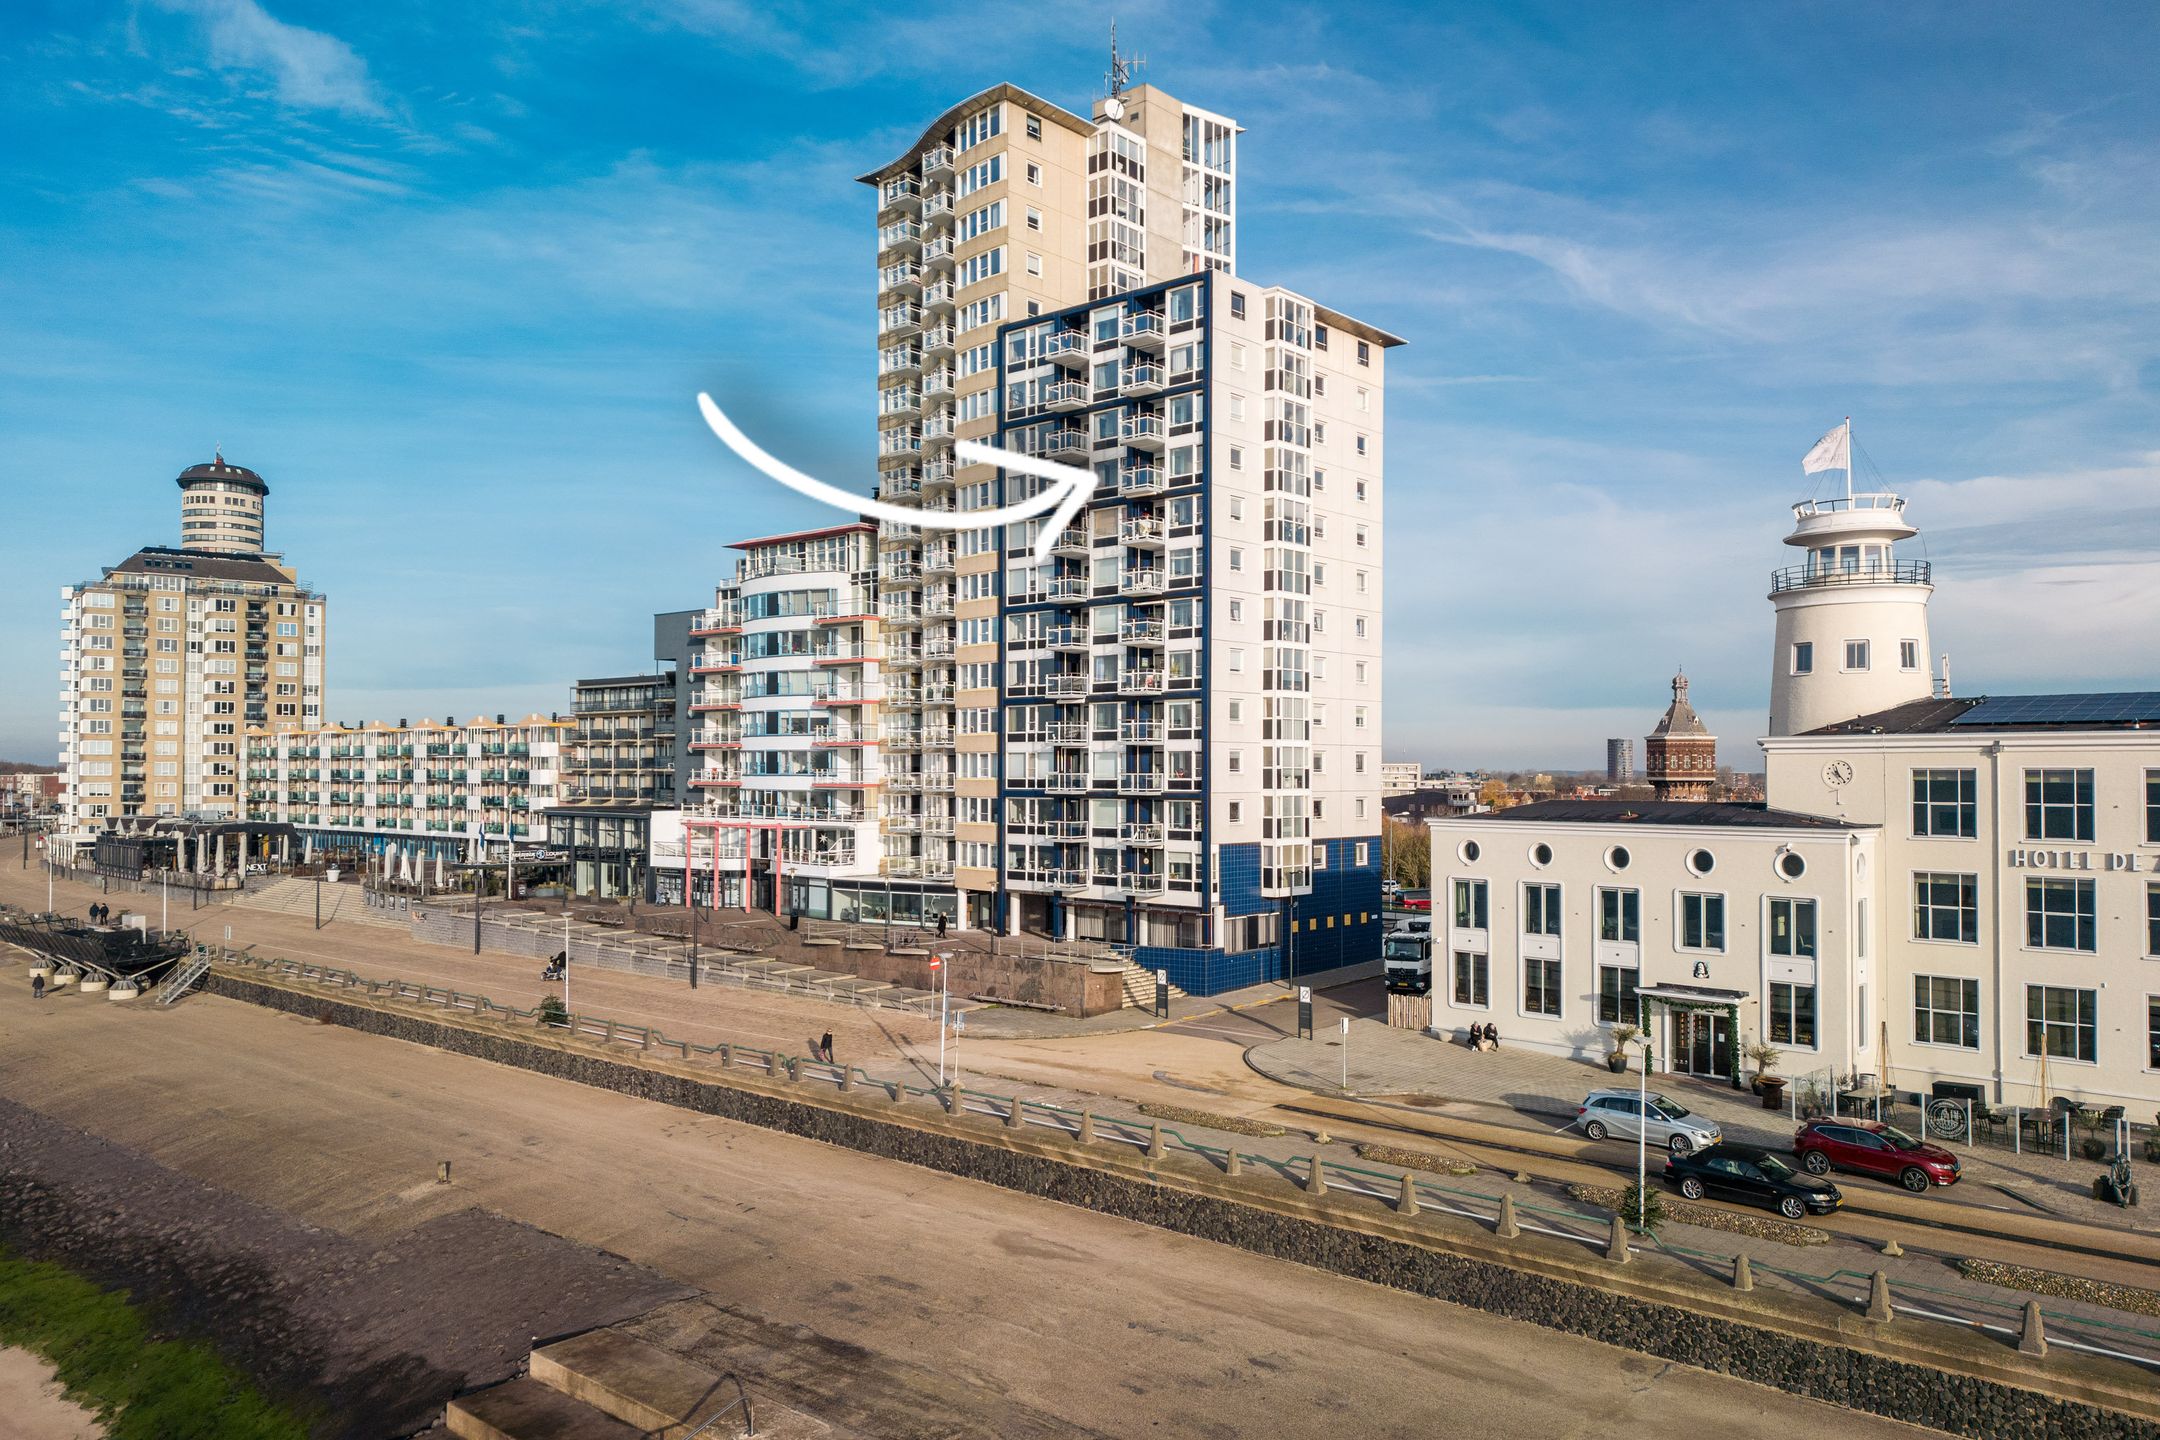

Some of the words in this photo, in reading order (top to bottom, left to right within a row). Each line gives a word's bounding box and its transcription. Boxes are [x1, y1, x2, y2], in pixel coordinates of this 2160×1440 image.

[246, 863, 267, 871] NEXT
[2014, 849, 2096, 870] HOTEL
[2112, 852, 2143, 872] DE
